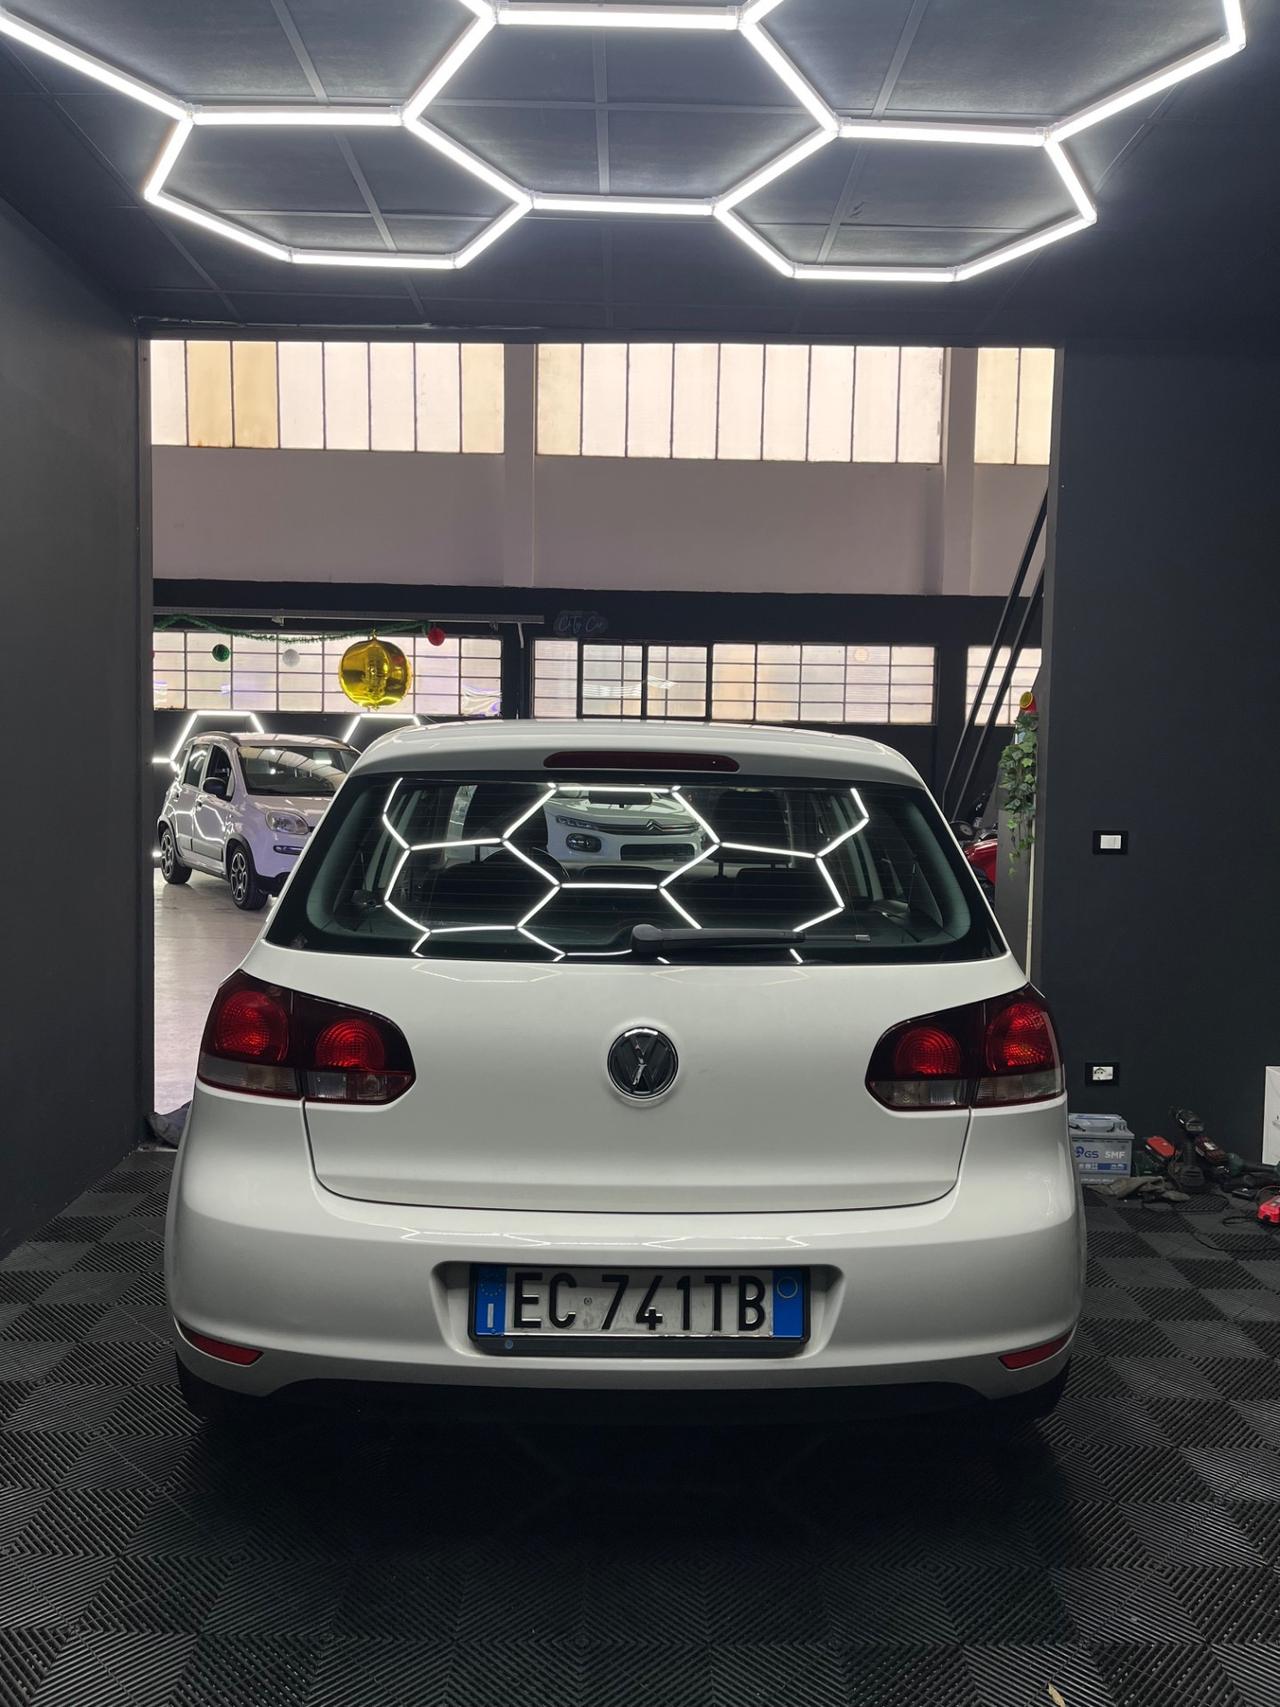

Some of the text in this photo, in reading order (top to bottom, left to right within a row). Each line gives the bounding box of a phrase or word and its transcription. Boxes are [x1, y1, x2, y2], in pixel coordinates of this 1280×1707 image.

[1104, 1151, 1125, 1159] SMF
[514, 1272, 577, 1329] EC
[601, 1274, 766, 1332] 741TB
